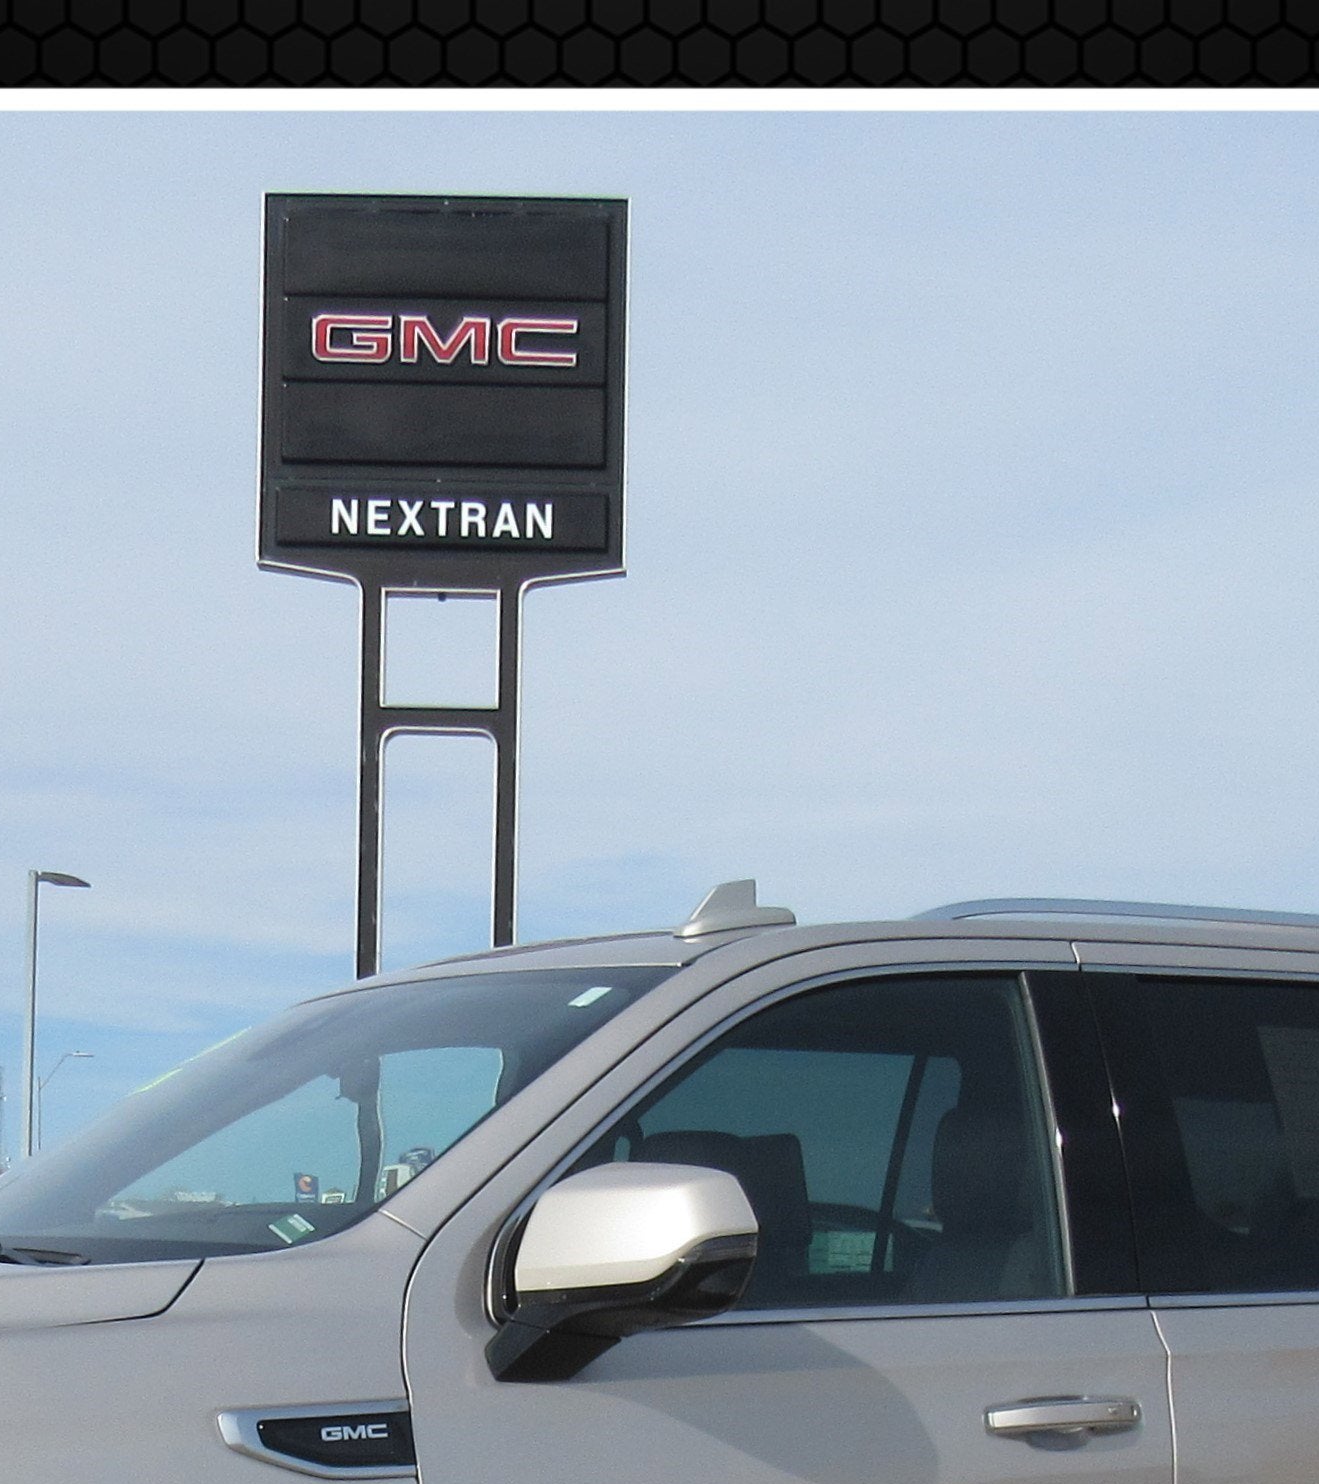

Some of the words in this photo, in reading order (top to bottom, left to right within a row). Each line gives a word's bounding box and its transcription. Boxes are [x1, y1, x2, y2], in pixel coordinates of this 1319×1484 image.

[311, 314, 578, 367] GMC
[330, 498, 554, 540] NEXTRAN
[321, 1423, 388, 1441] GMC
